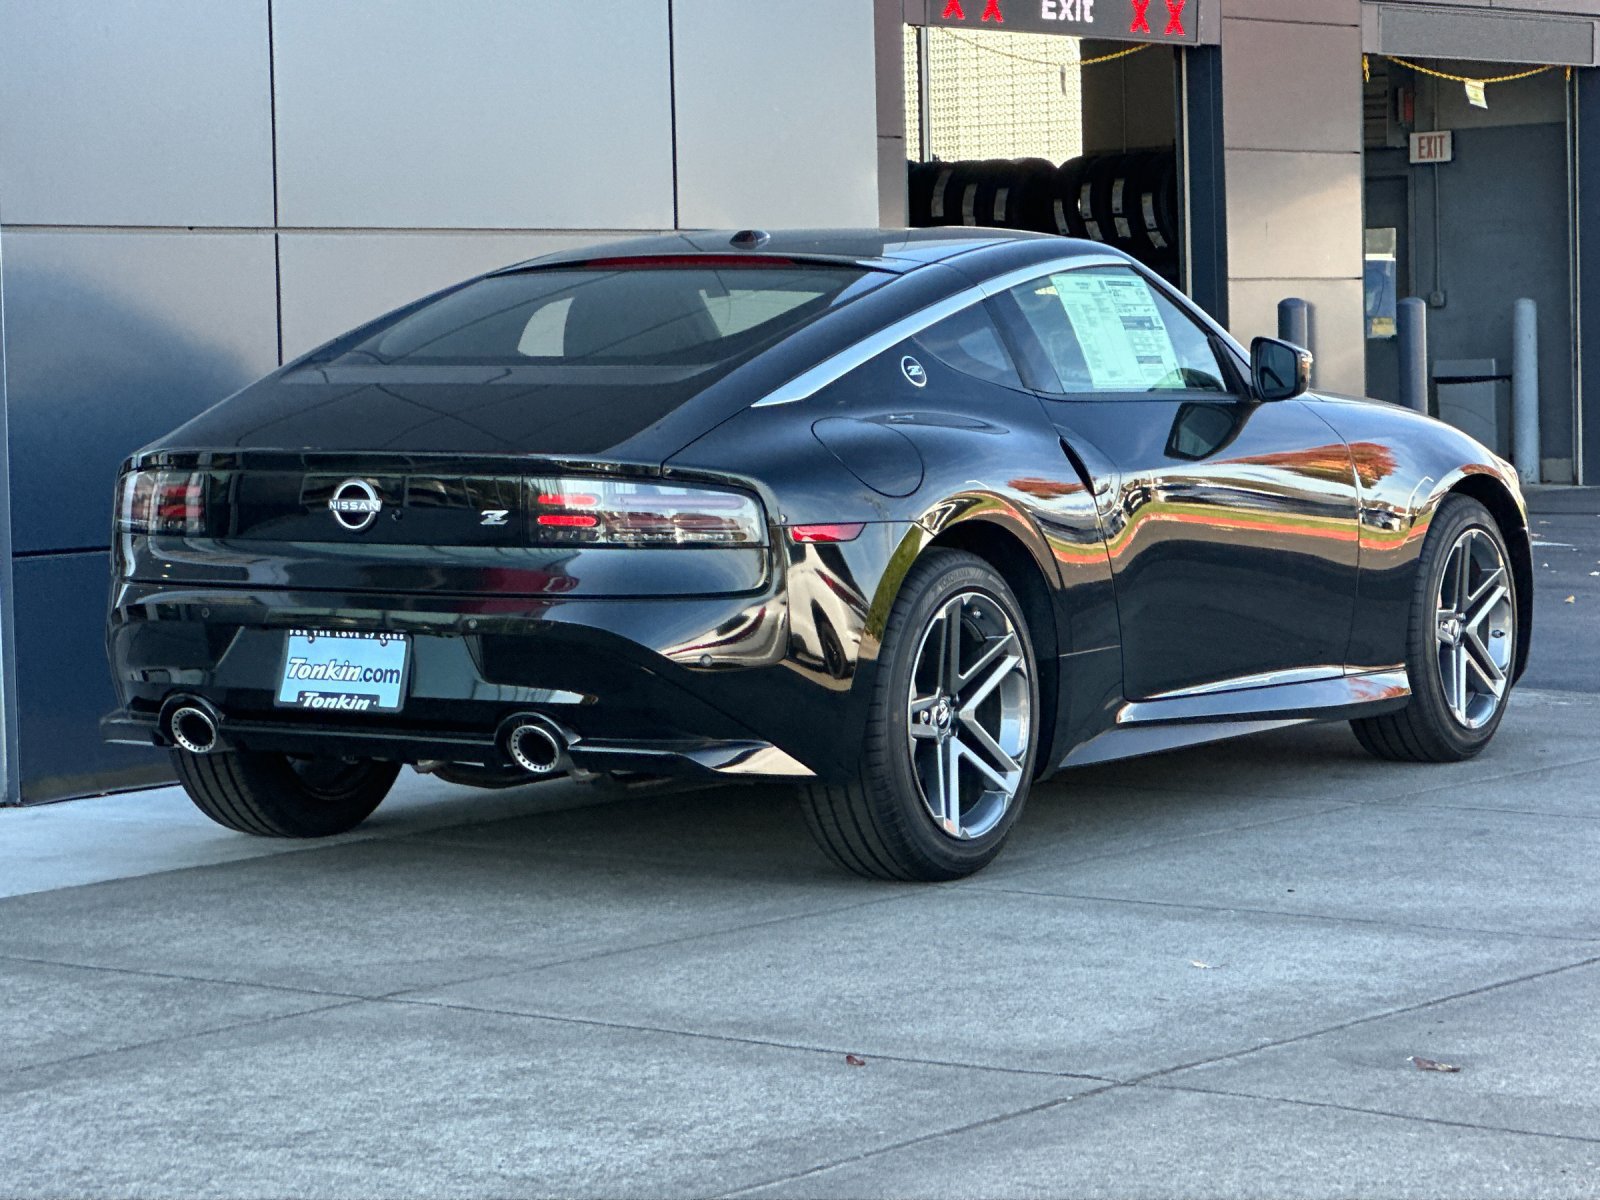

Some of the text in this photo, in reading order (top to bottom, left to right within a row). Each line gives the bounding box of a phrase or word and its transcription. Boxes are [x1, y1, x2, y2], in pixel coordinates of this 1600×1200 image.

[1418, 135, 1445, 160] EXIT
[329, 501, 379, 511] NISSAN
[480, 509, 509, 525] Z
[289, 629, 308, 637] FOR
[313, 629, 331, 638] THE
[335, 631, 360, 639] LOVE
[379, 633, 404, 641] CARS
[286, 657, 401, 684] Tonkin.com
[303, 692, 370, 710] Tonkin
